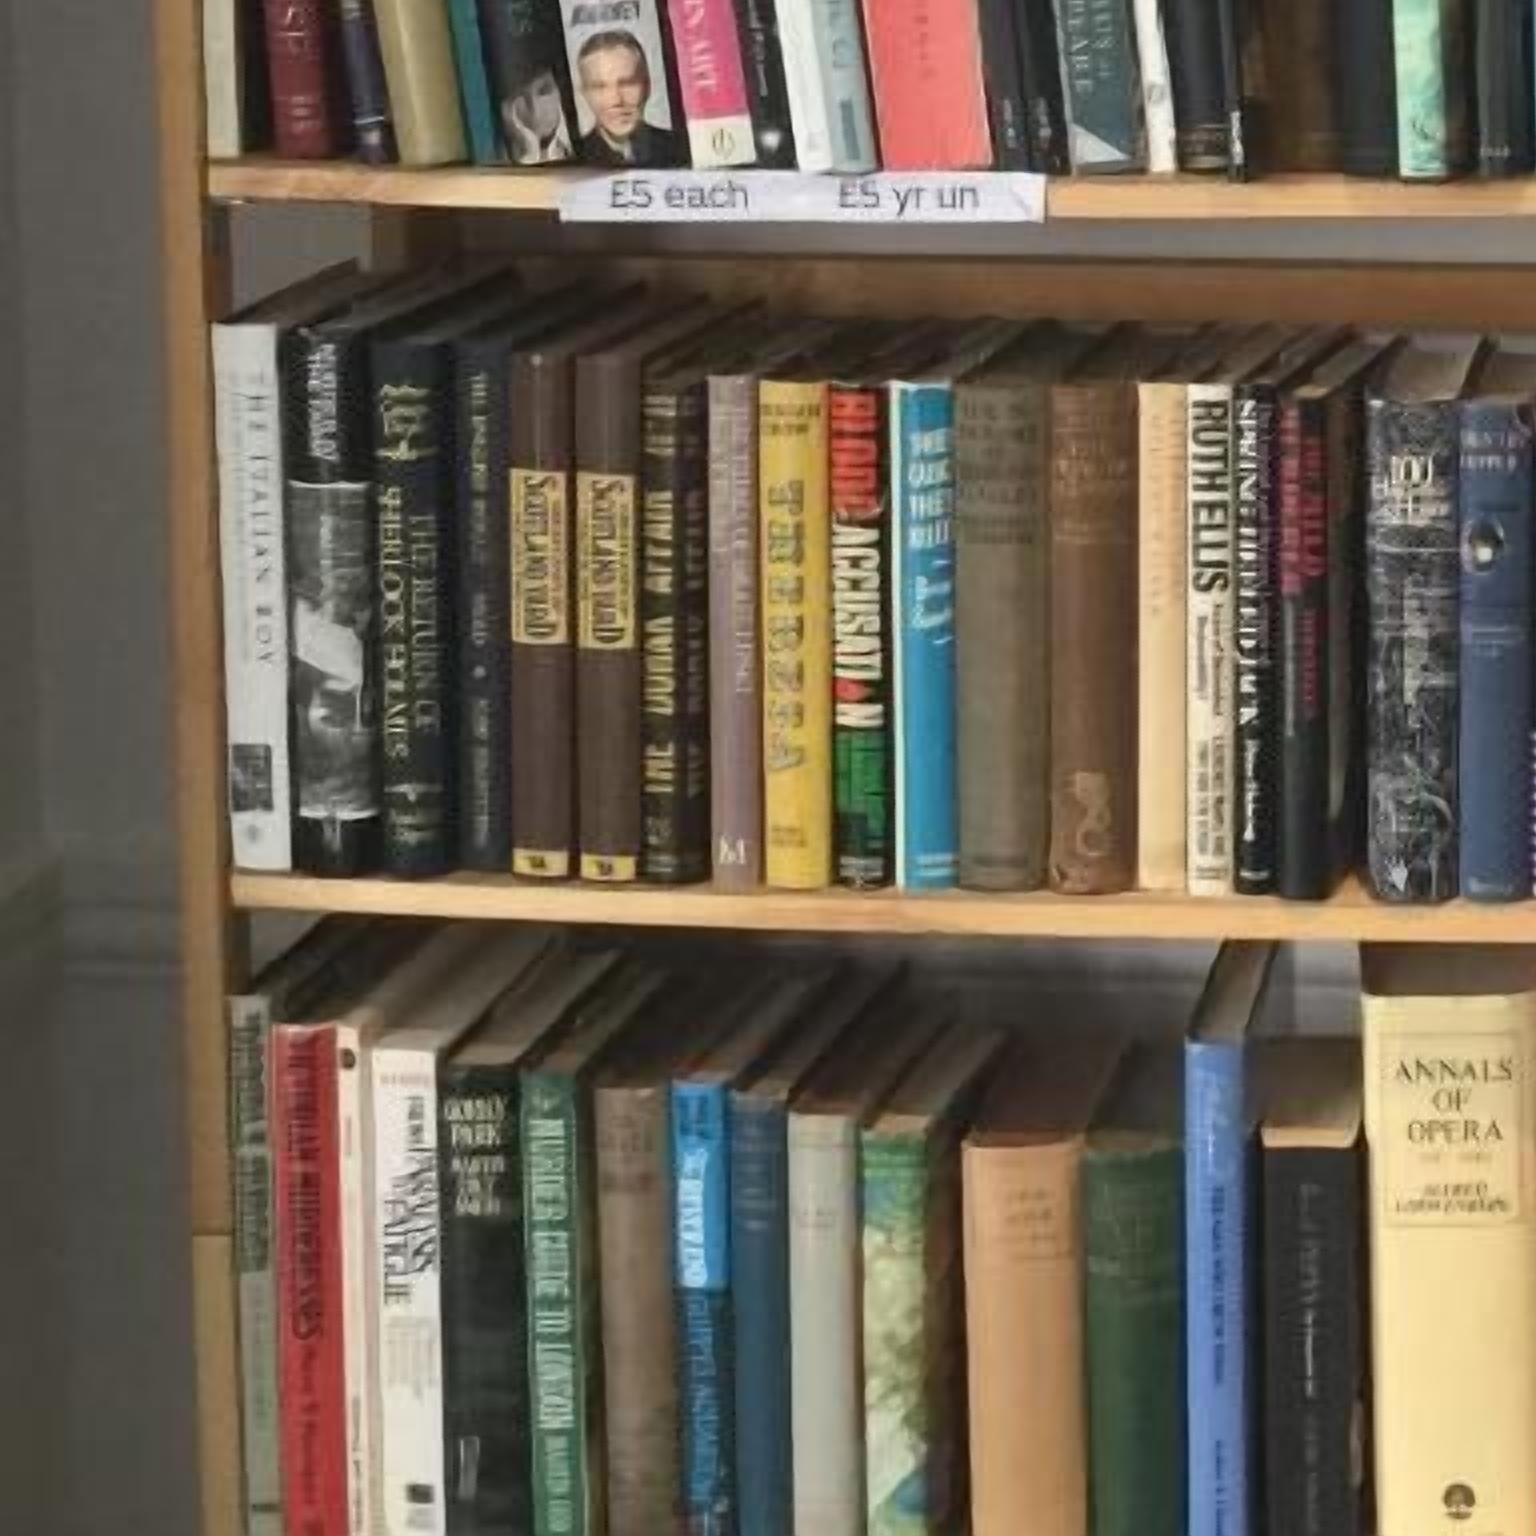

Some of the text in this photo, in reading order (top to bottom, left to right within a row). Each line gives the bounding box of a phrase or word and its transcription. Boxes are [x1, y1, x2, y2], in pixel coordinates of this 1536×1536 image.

[687, 34, 721, 97] ART
[664, 178, 748, 212] each
[892, 187, 926, 216] yr
[937, 187, 979, 210] un
[829, 391, 884, 519] BLOOD
[1190, 399, 1230, 493] RUTH
[239, 368, 276, 669] THE ITALIAN BOY
[523, 475, 557, 580] SCOTLAND
[589, 479, 626, 584] SCOTLAND
[1191, 500, 1230, 593] ELLIS
[378, 486, 408, 759] SHERLOCK HOLMES
[408, 512, 440, 735] THE RETURN OF
[1395, 1056, 1514, 1084] ANNALS
[1431, 1087, 1472, 1113] OF
[531, 1117, 569, 1221] MURDER
[1406, 1118, 1504, 1145] OPERA
[535, 1304, 571, 1333] TO
[535, 1340, 573, 1429] LONDON
